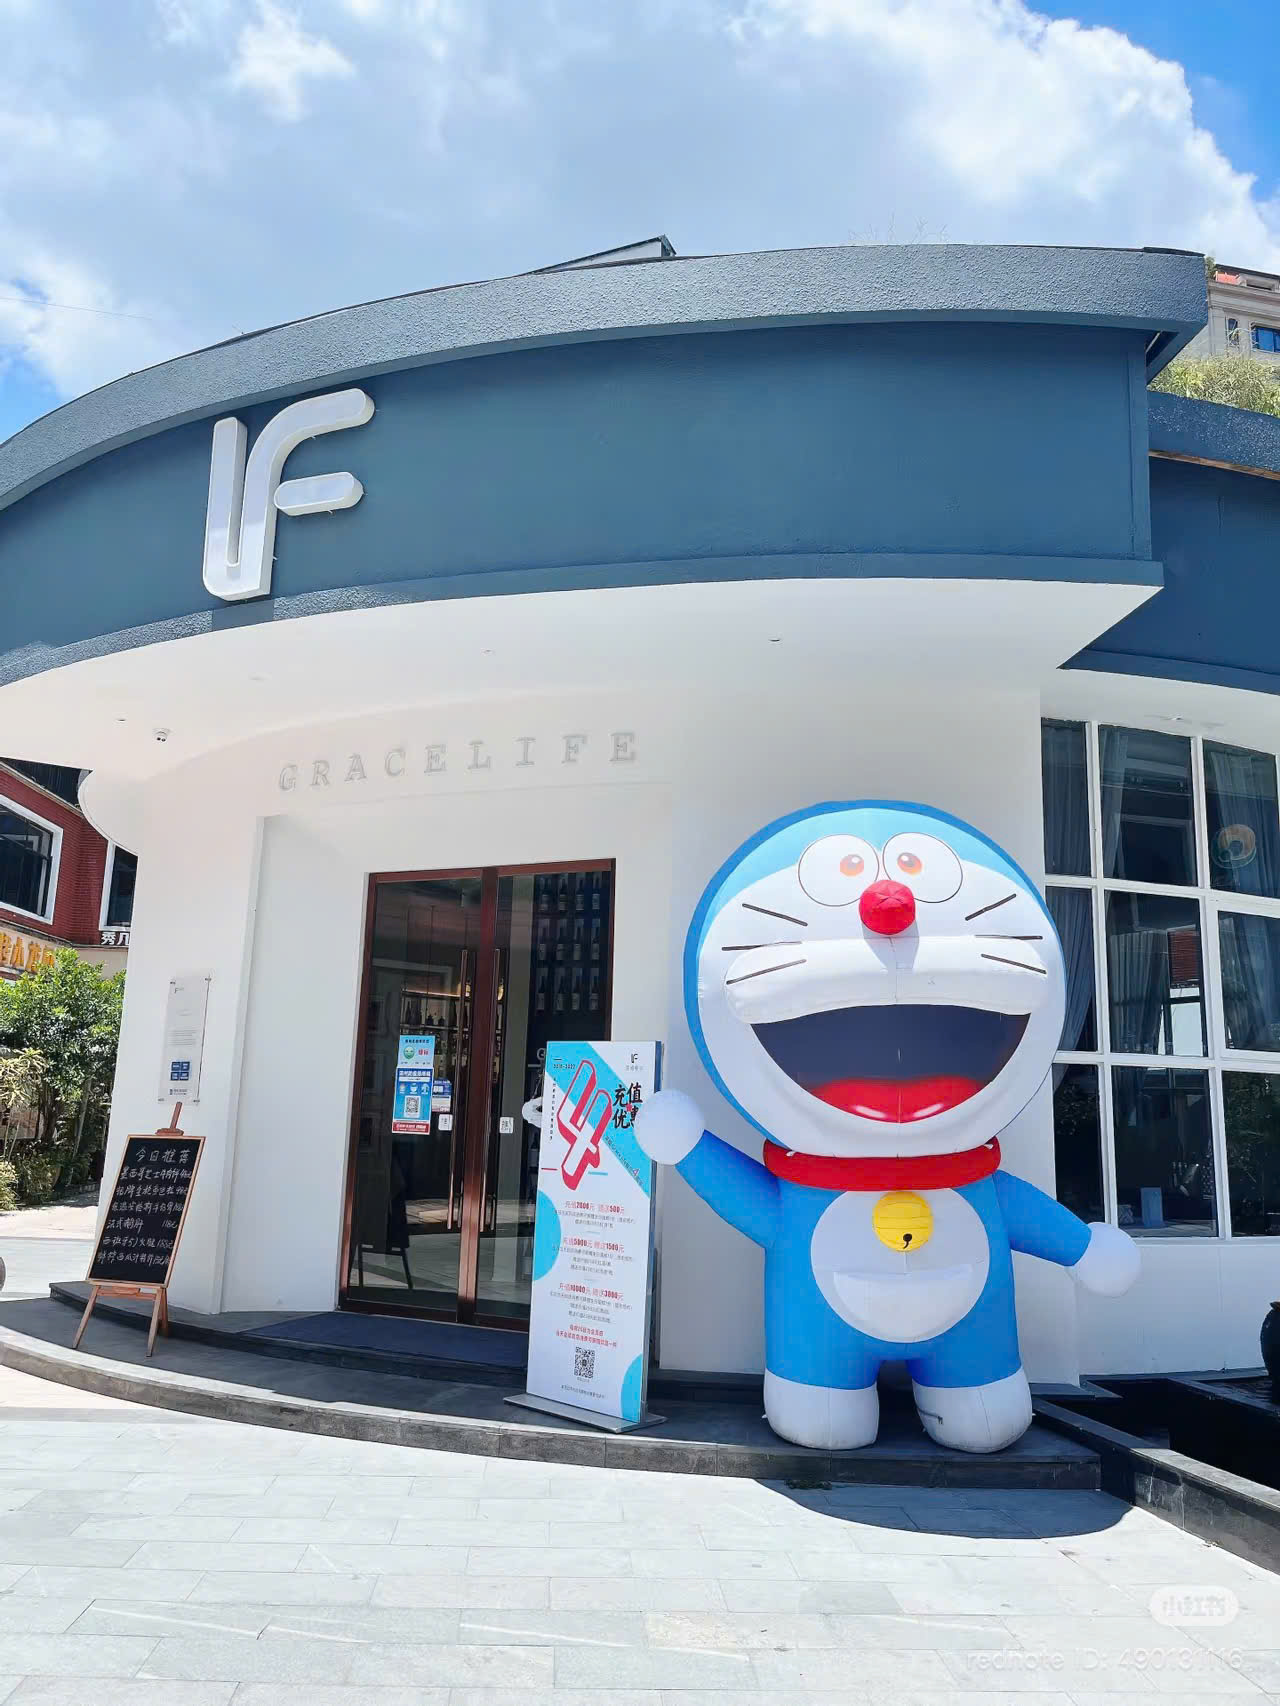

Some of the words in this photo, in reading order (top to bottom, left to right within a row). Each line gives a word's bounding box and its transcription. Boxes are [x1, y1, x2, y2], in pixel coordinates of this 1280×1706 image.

[612, 1081, 643, 1108] 充值
[135, 1146, 192, 1164] 今日推荐
